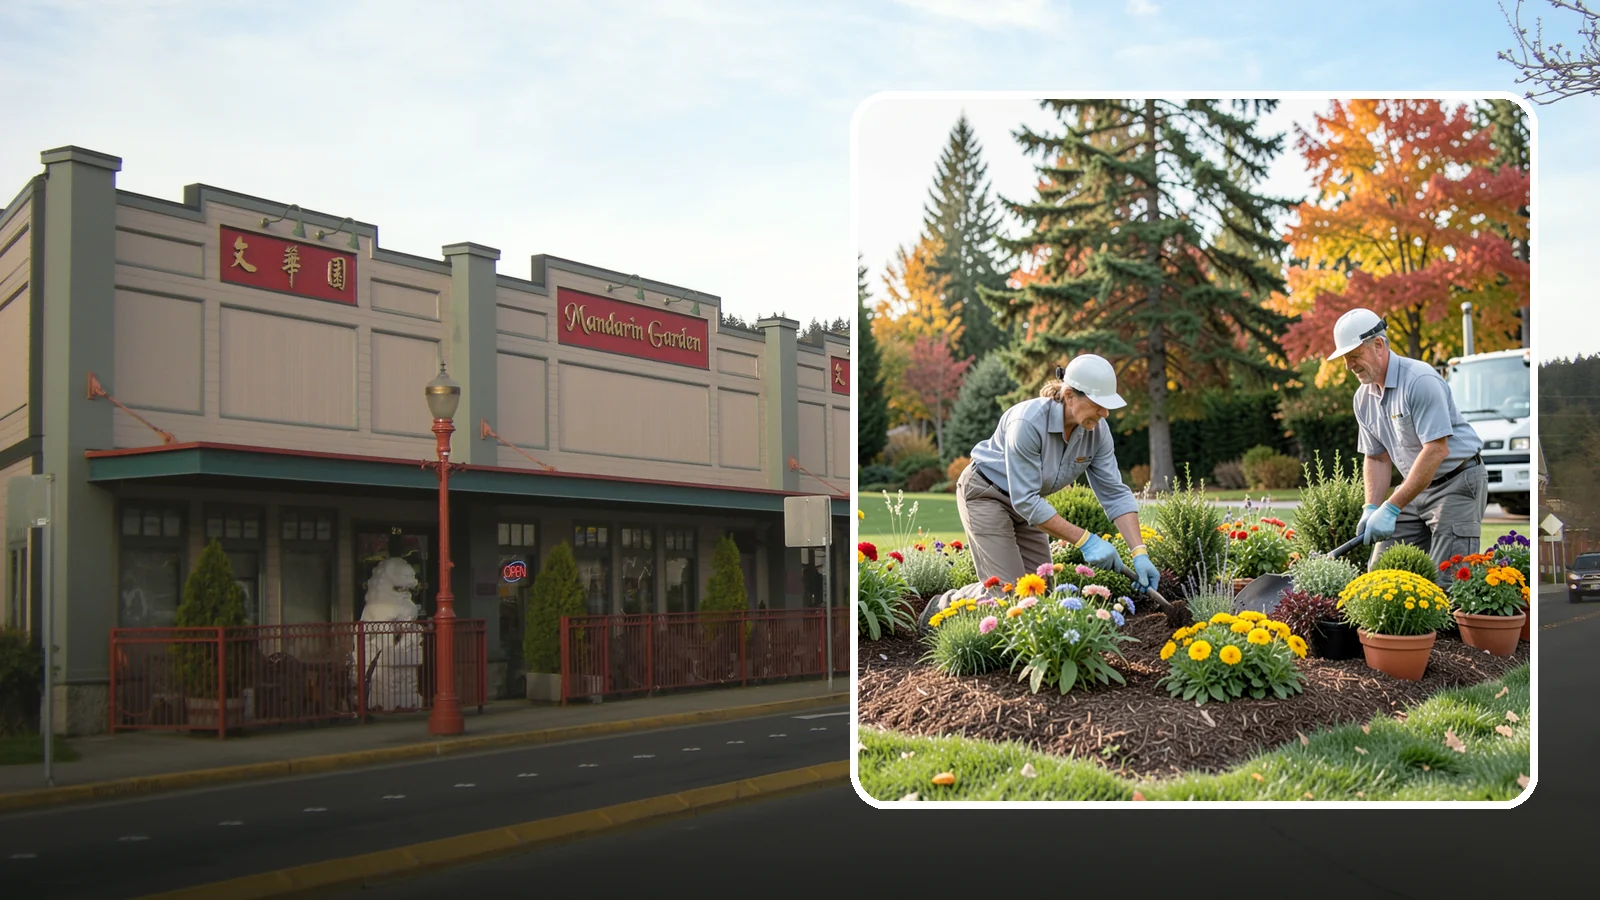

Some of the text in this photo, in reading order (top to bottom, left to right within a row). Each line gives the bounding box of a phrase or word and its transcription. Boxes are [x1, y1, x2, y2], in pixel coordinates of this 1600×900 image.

[231, 235, 346, 291] 文華園
[564, 302, 701, 352] Mandarin Garden
[503, 565, 527, 578] OPEN
